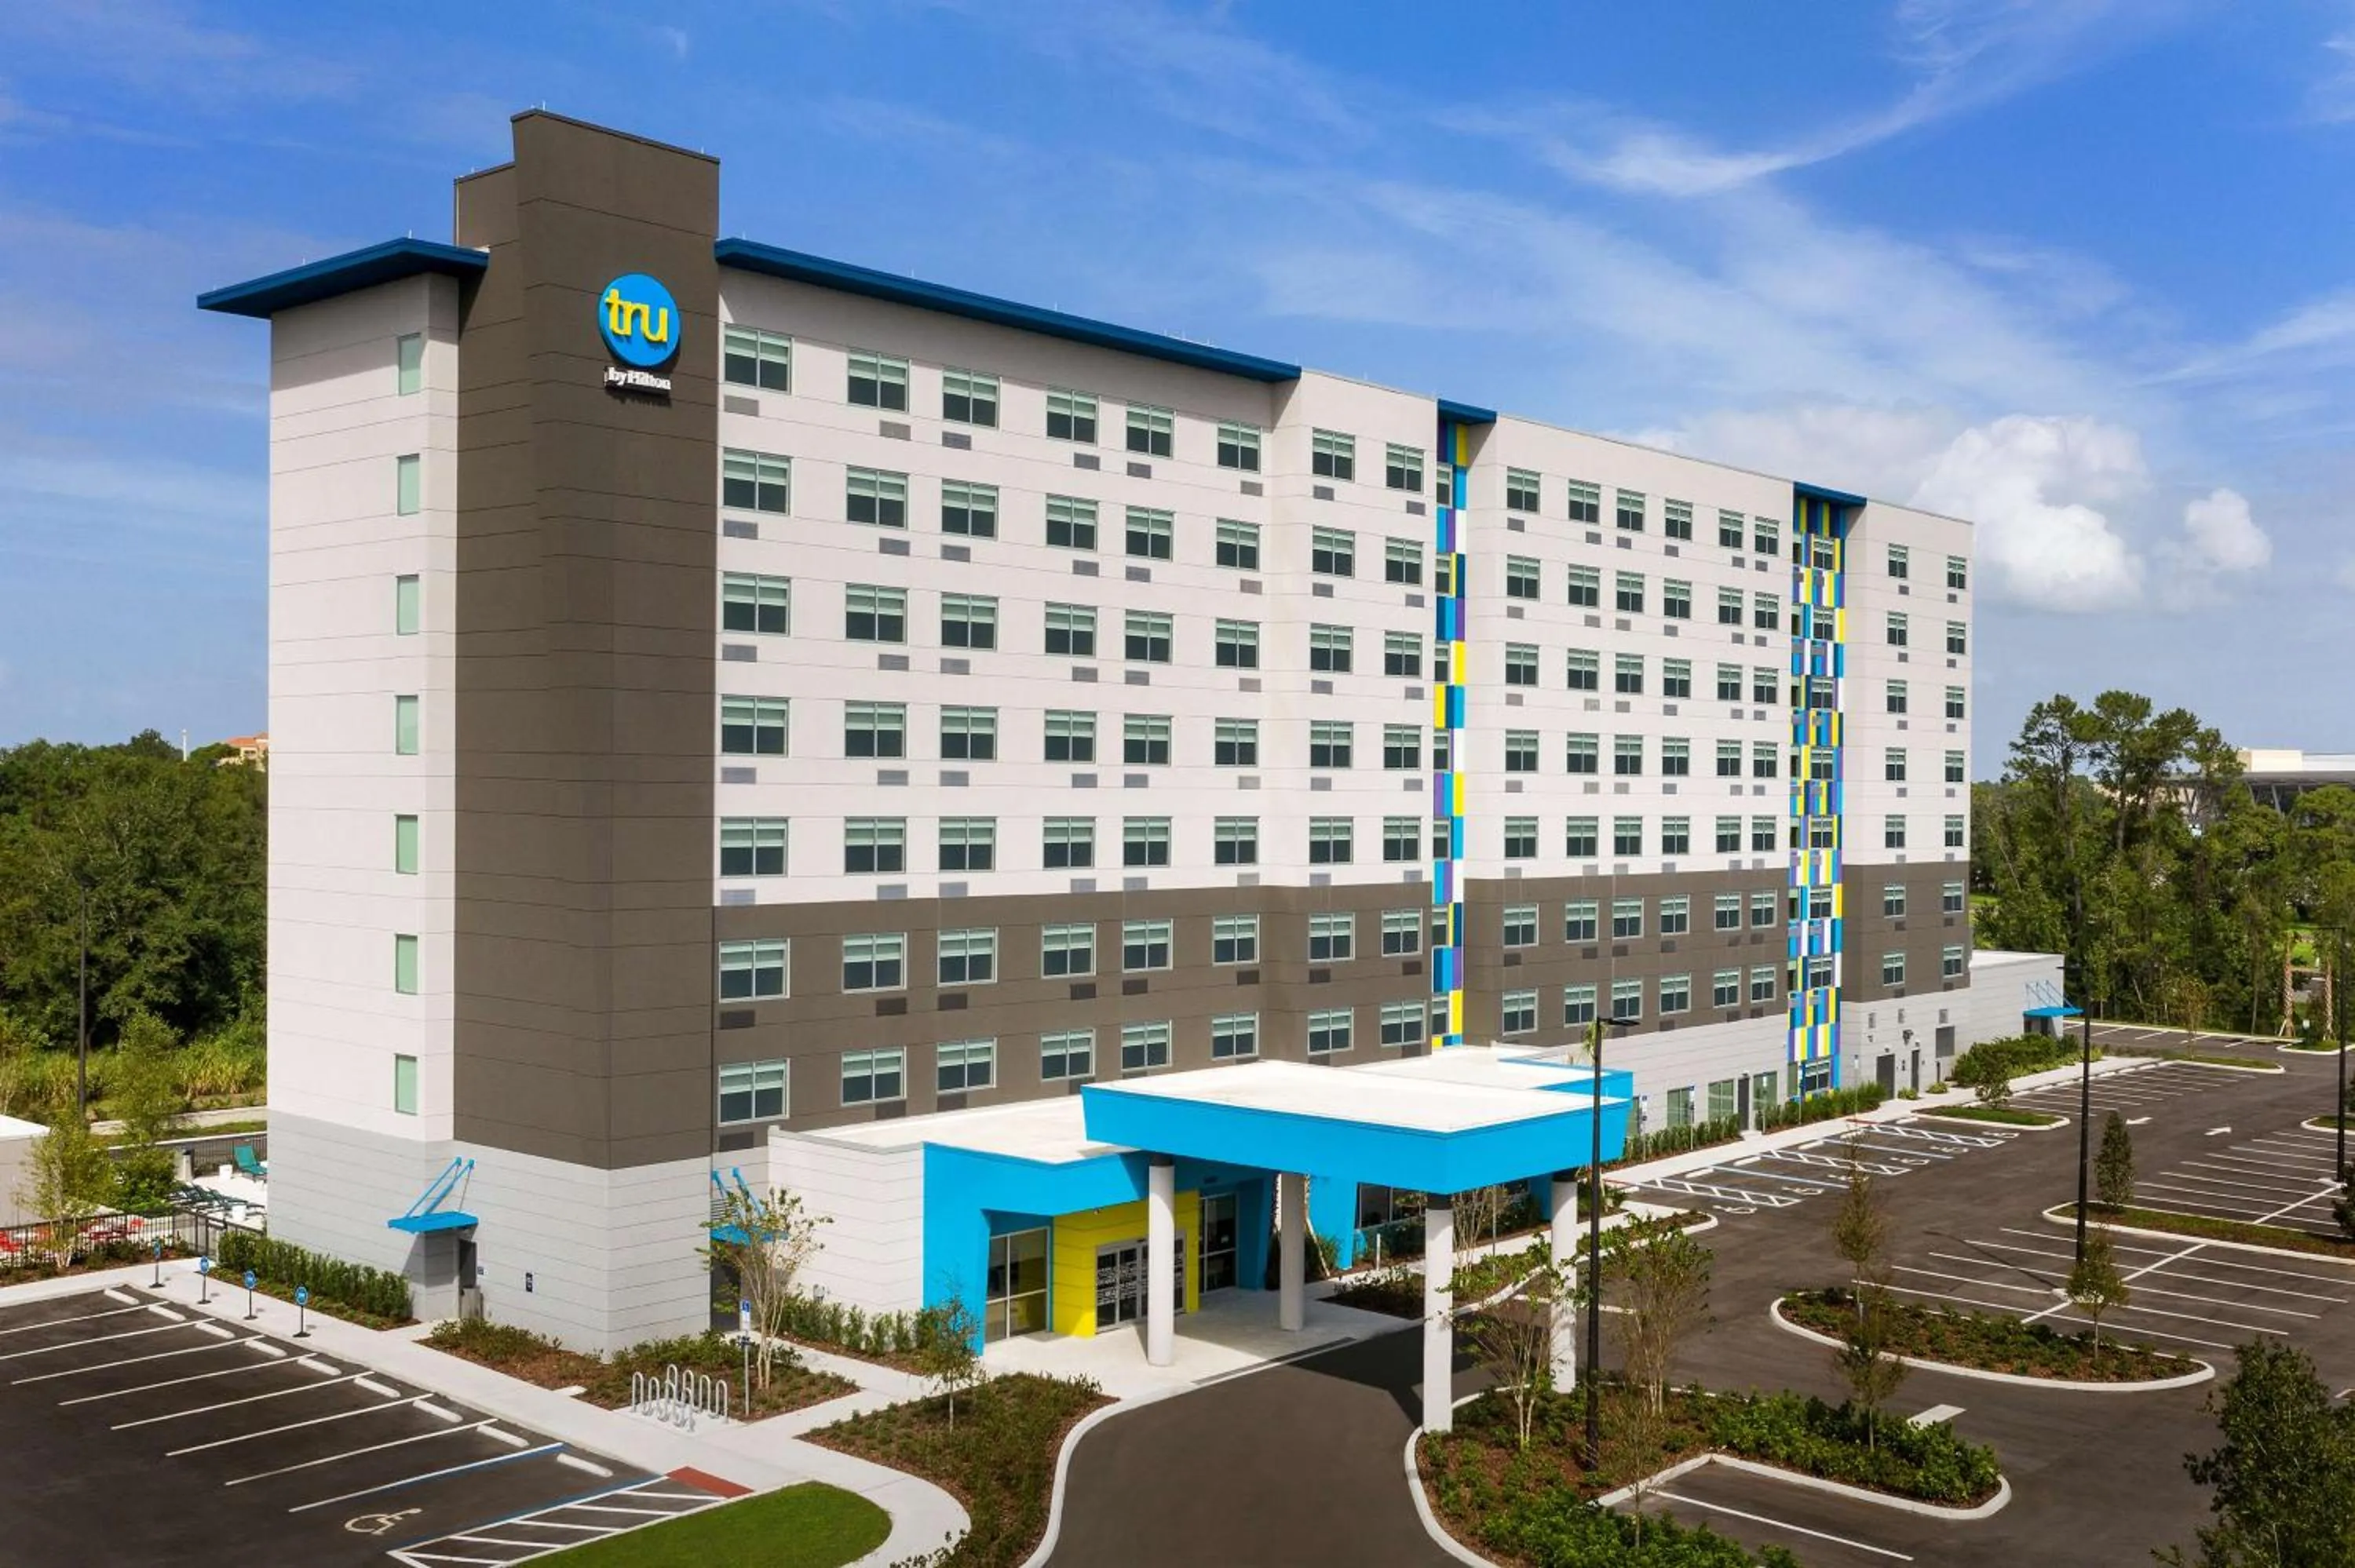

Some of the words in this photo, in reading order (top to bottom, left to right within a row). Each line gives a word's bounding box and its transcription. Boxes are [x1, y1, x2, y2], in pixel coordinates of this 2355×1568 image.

[604, 289, 669, 343] tru
[608, 366, 627, 386] by
[627, 370, 671, 390] Hilton
